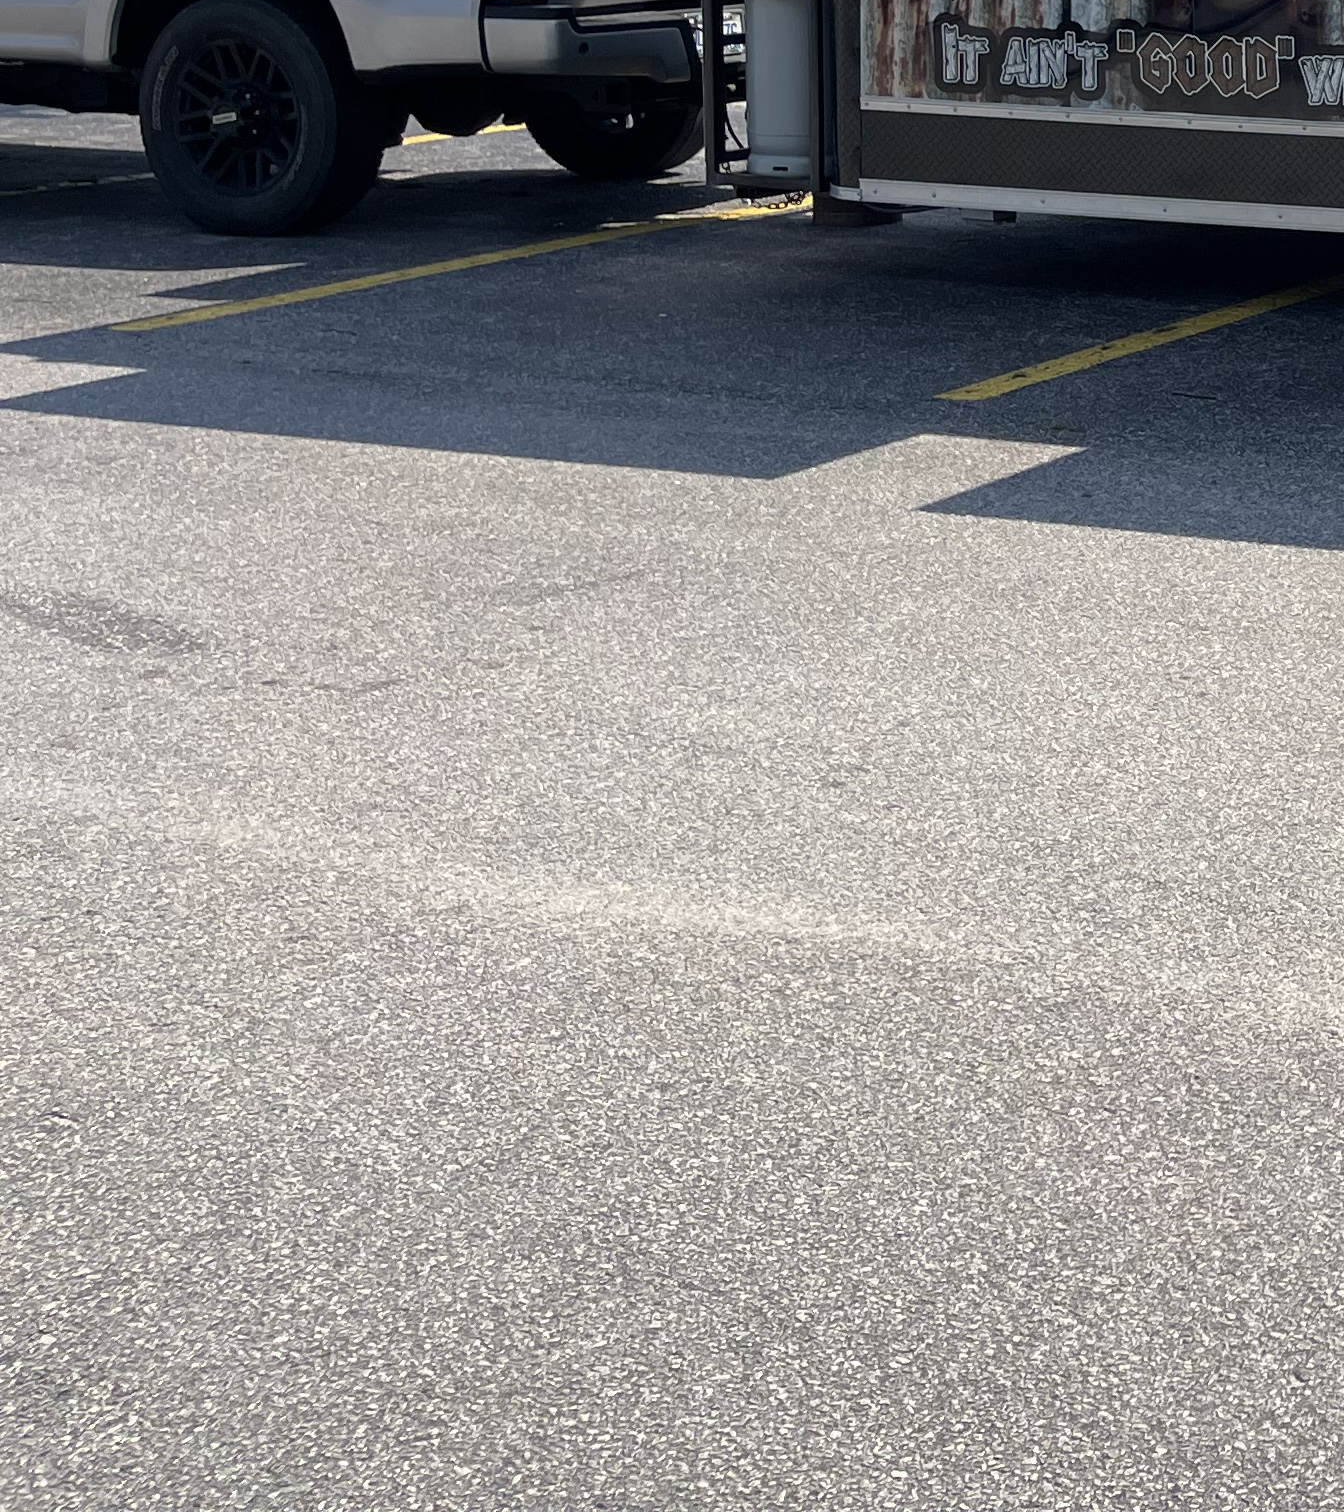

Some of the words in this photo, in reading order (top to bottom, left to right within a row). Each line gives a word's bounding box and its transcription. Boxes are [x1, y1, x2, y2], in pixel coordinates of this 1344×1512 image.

[941, 23, 990, 84] IT
[1000, 31, 1108, 91] AIN'T
[1116, 29, 1294, 100] "GOOD"
